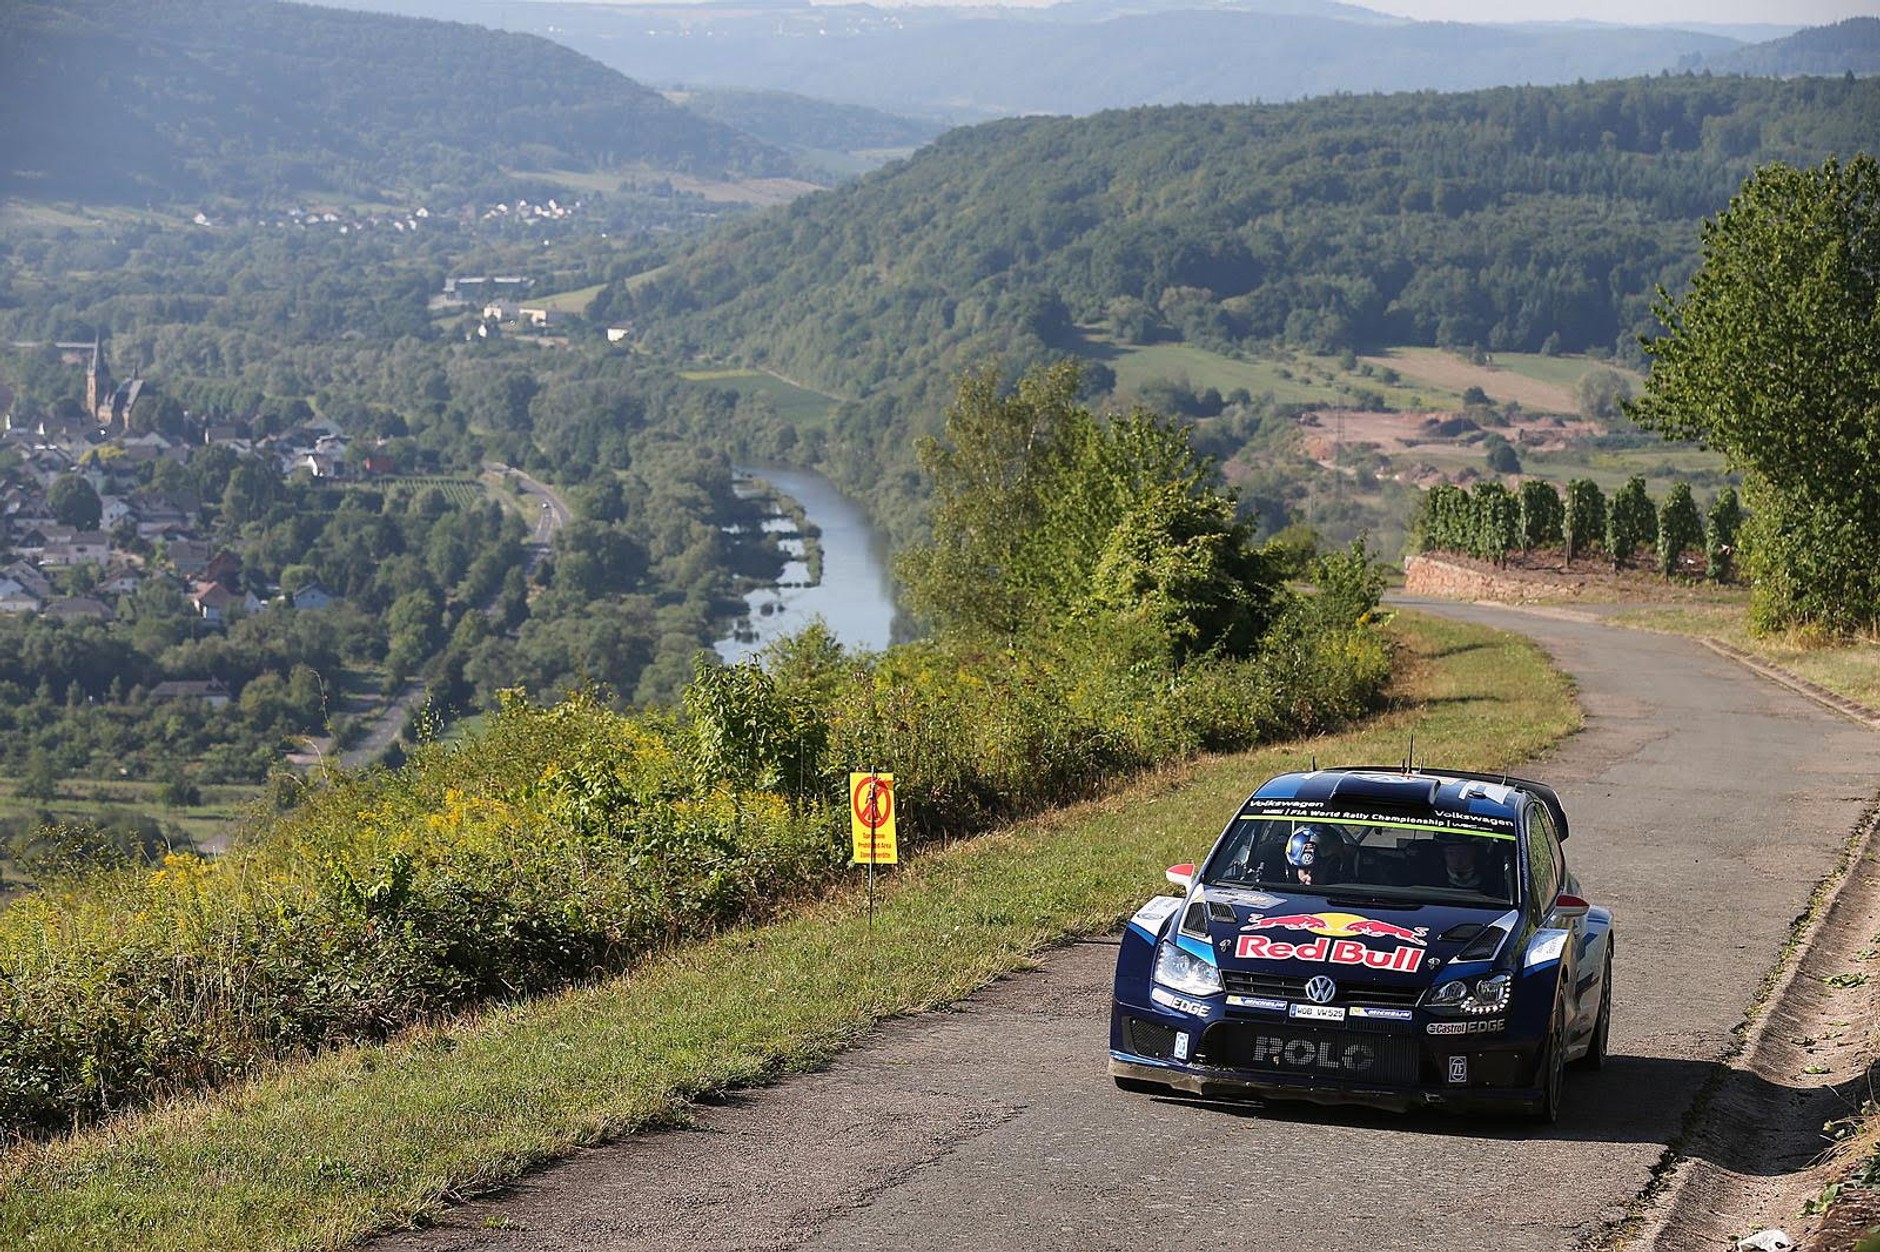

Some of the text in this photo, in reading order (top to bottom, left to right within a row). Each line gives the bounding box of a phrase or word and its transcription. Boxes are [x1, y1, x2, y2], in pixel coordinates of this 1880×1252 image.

[1250, 800, 1324, 808] Volkswagen
[1310, 810, 1341, 818] World
[1342, 811, 1369, 820] Rally
[1371, 813, 1444, 827] Championship
[1434, 810, 1514, 827] Volkswagen
[1236, 935, 1425, 972] Red Bull
[1172, 997, 1212, 1017] EDGE
[1437, 1019, 1505, 1034] Castrol EDGE
[1253, 1036, 1374, 1069] POLO
[1453, 1062, 1464, 1075] ZF
